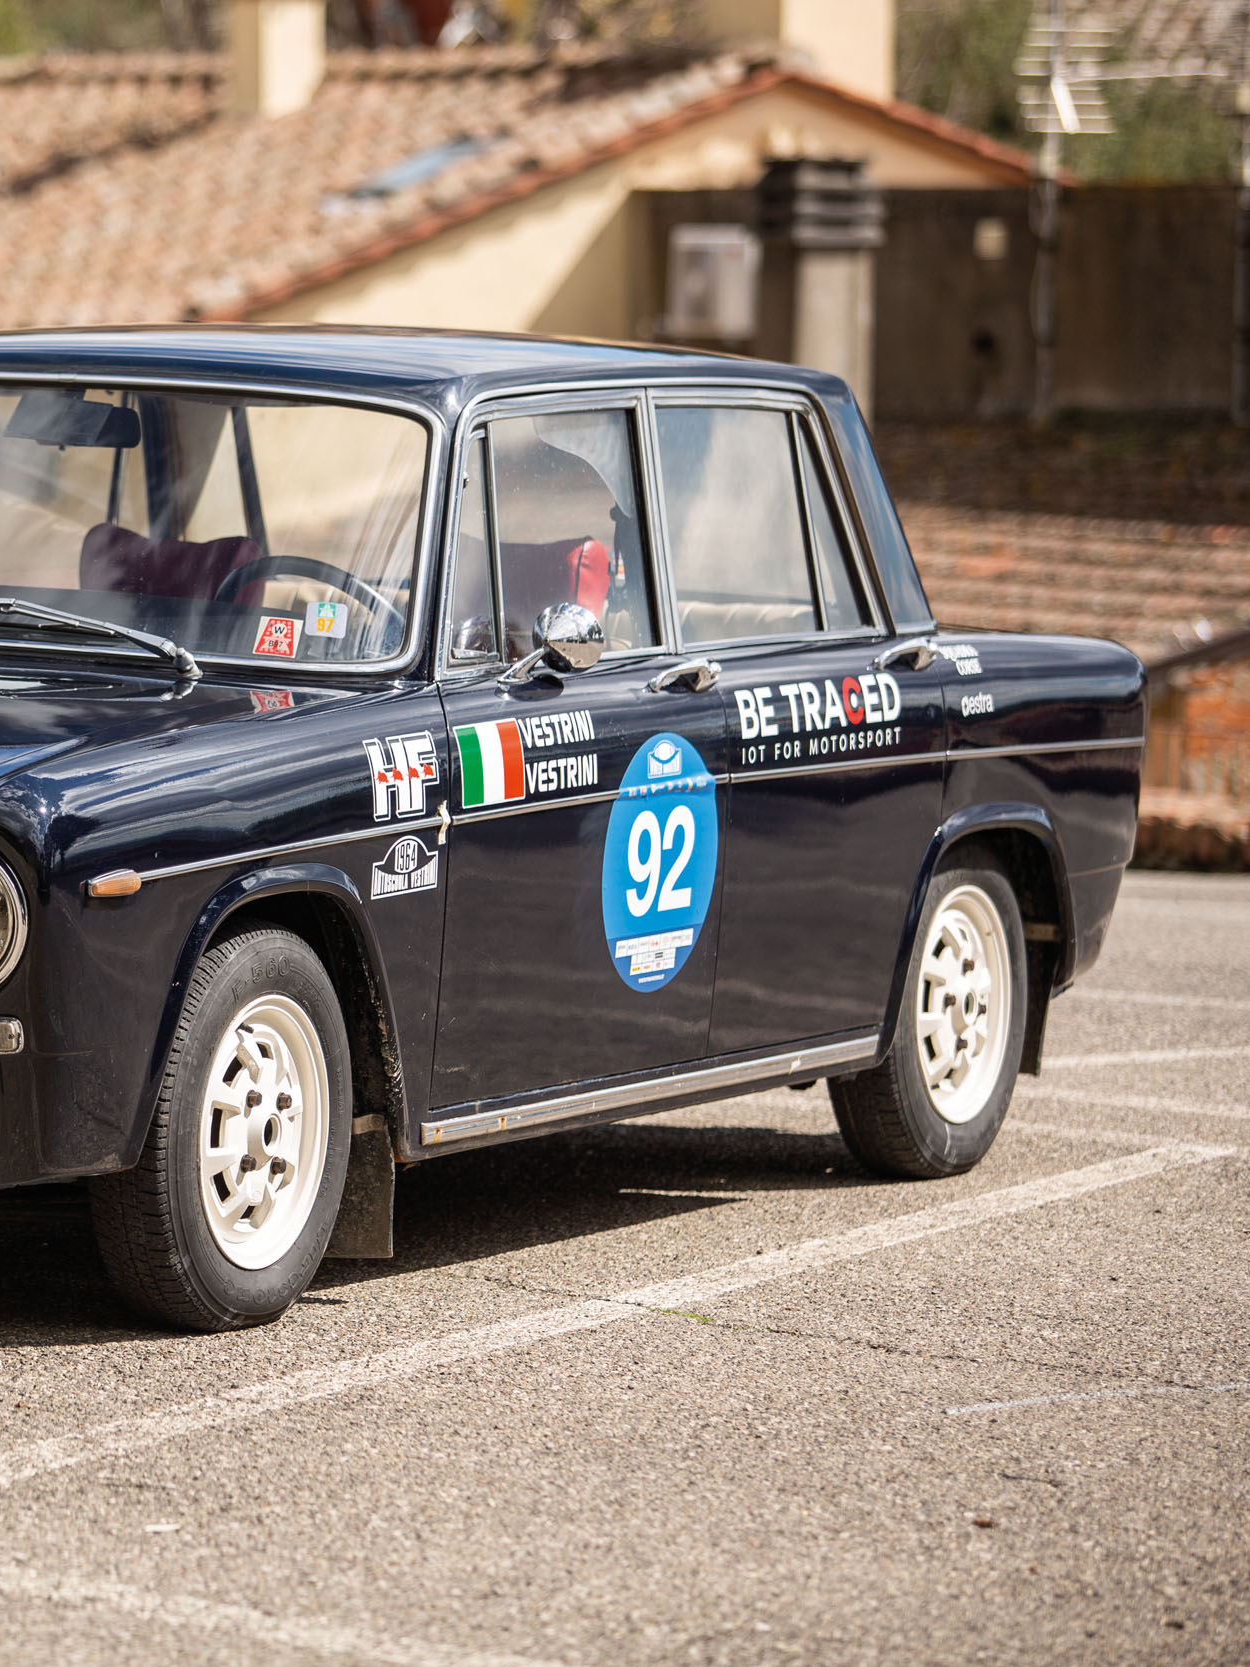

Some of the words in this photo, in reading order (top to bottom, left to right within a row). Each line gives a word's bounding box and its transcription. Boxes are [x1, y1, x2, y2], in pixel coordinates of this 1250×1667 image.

[274, 626, 285, 635] W
[317, 618, 334, 632] 97
[734, 686, 779, 740] BE
[779, 672, 901, 733] TRACED
[517, 709, 595, 749] VESTRINI
[742, 745, 766, 765] IOT
[774, 740, 801, 760] FOR
[809, 726, 902, 756] MOTORSPORT
[362, 730, 440, 822] HF
[525, 753, 598, 794] VESTRINI
[396, 843, 417, 871] 1964
[626, 805, 696, 918] 92
[232, 955, 290, 1002] F-560
